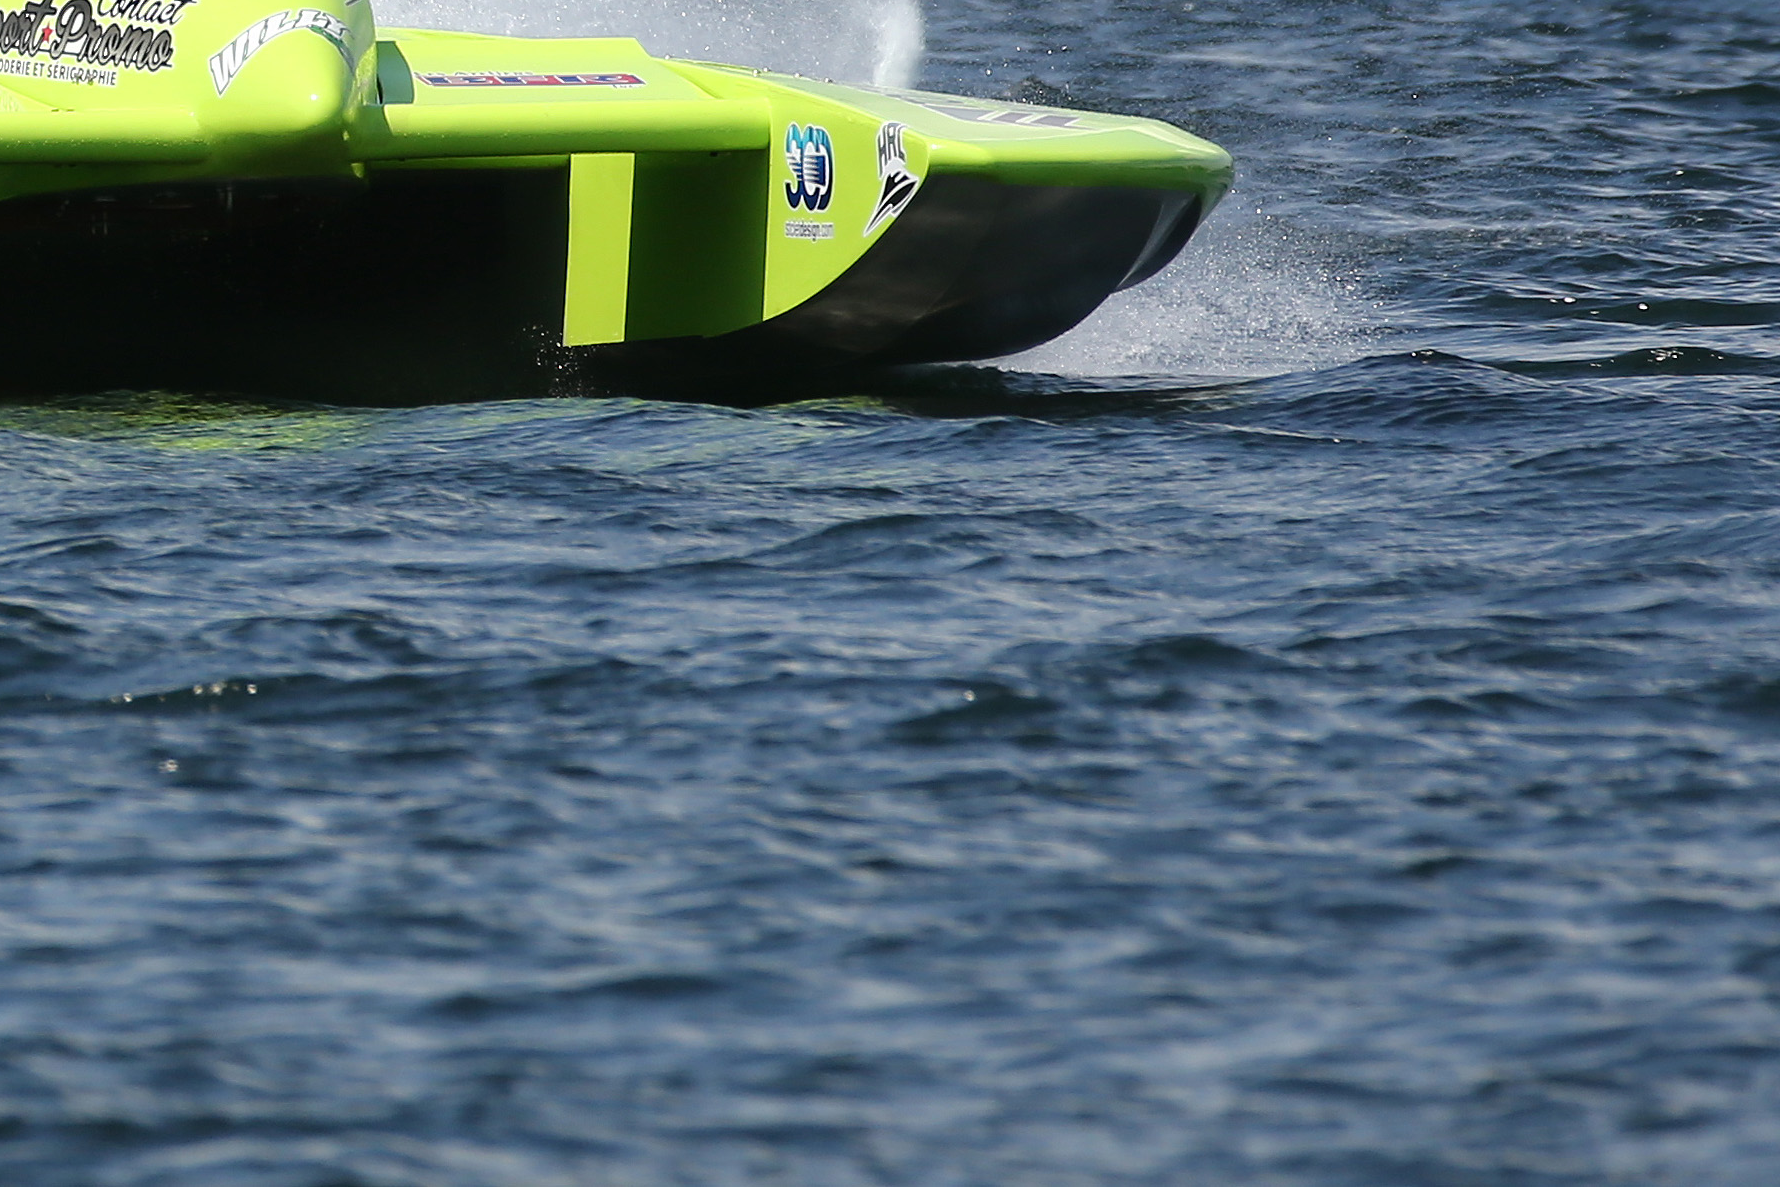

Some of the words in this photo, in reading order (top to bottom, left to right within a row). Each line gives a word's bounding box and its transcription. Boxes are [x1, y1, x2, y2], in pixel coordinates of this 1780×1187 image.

[33, 62, 45, 77] ET
[47, 61, 118, 86] SÉRIGRAPHIE
[209, 9, 354, 95] WILLY
